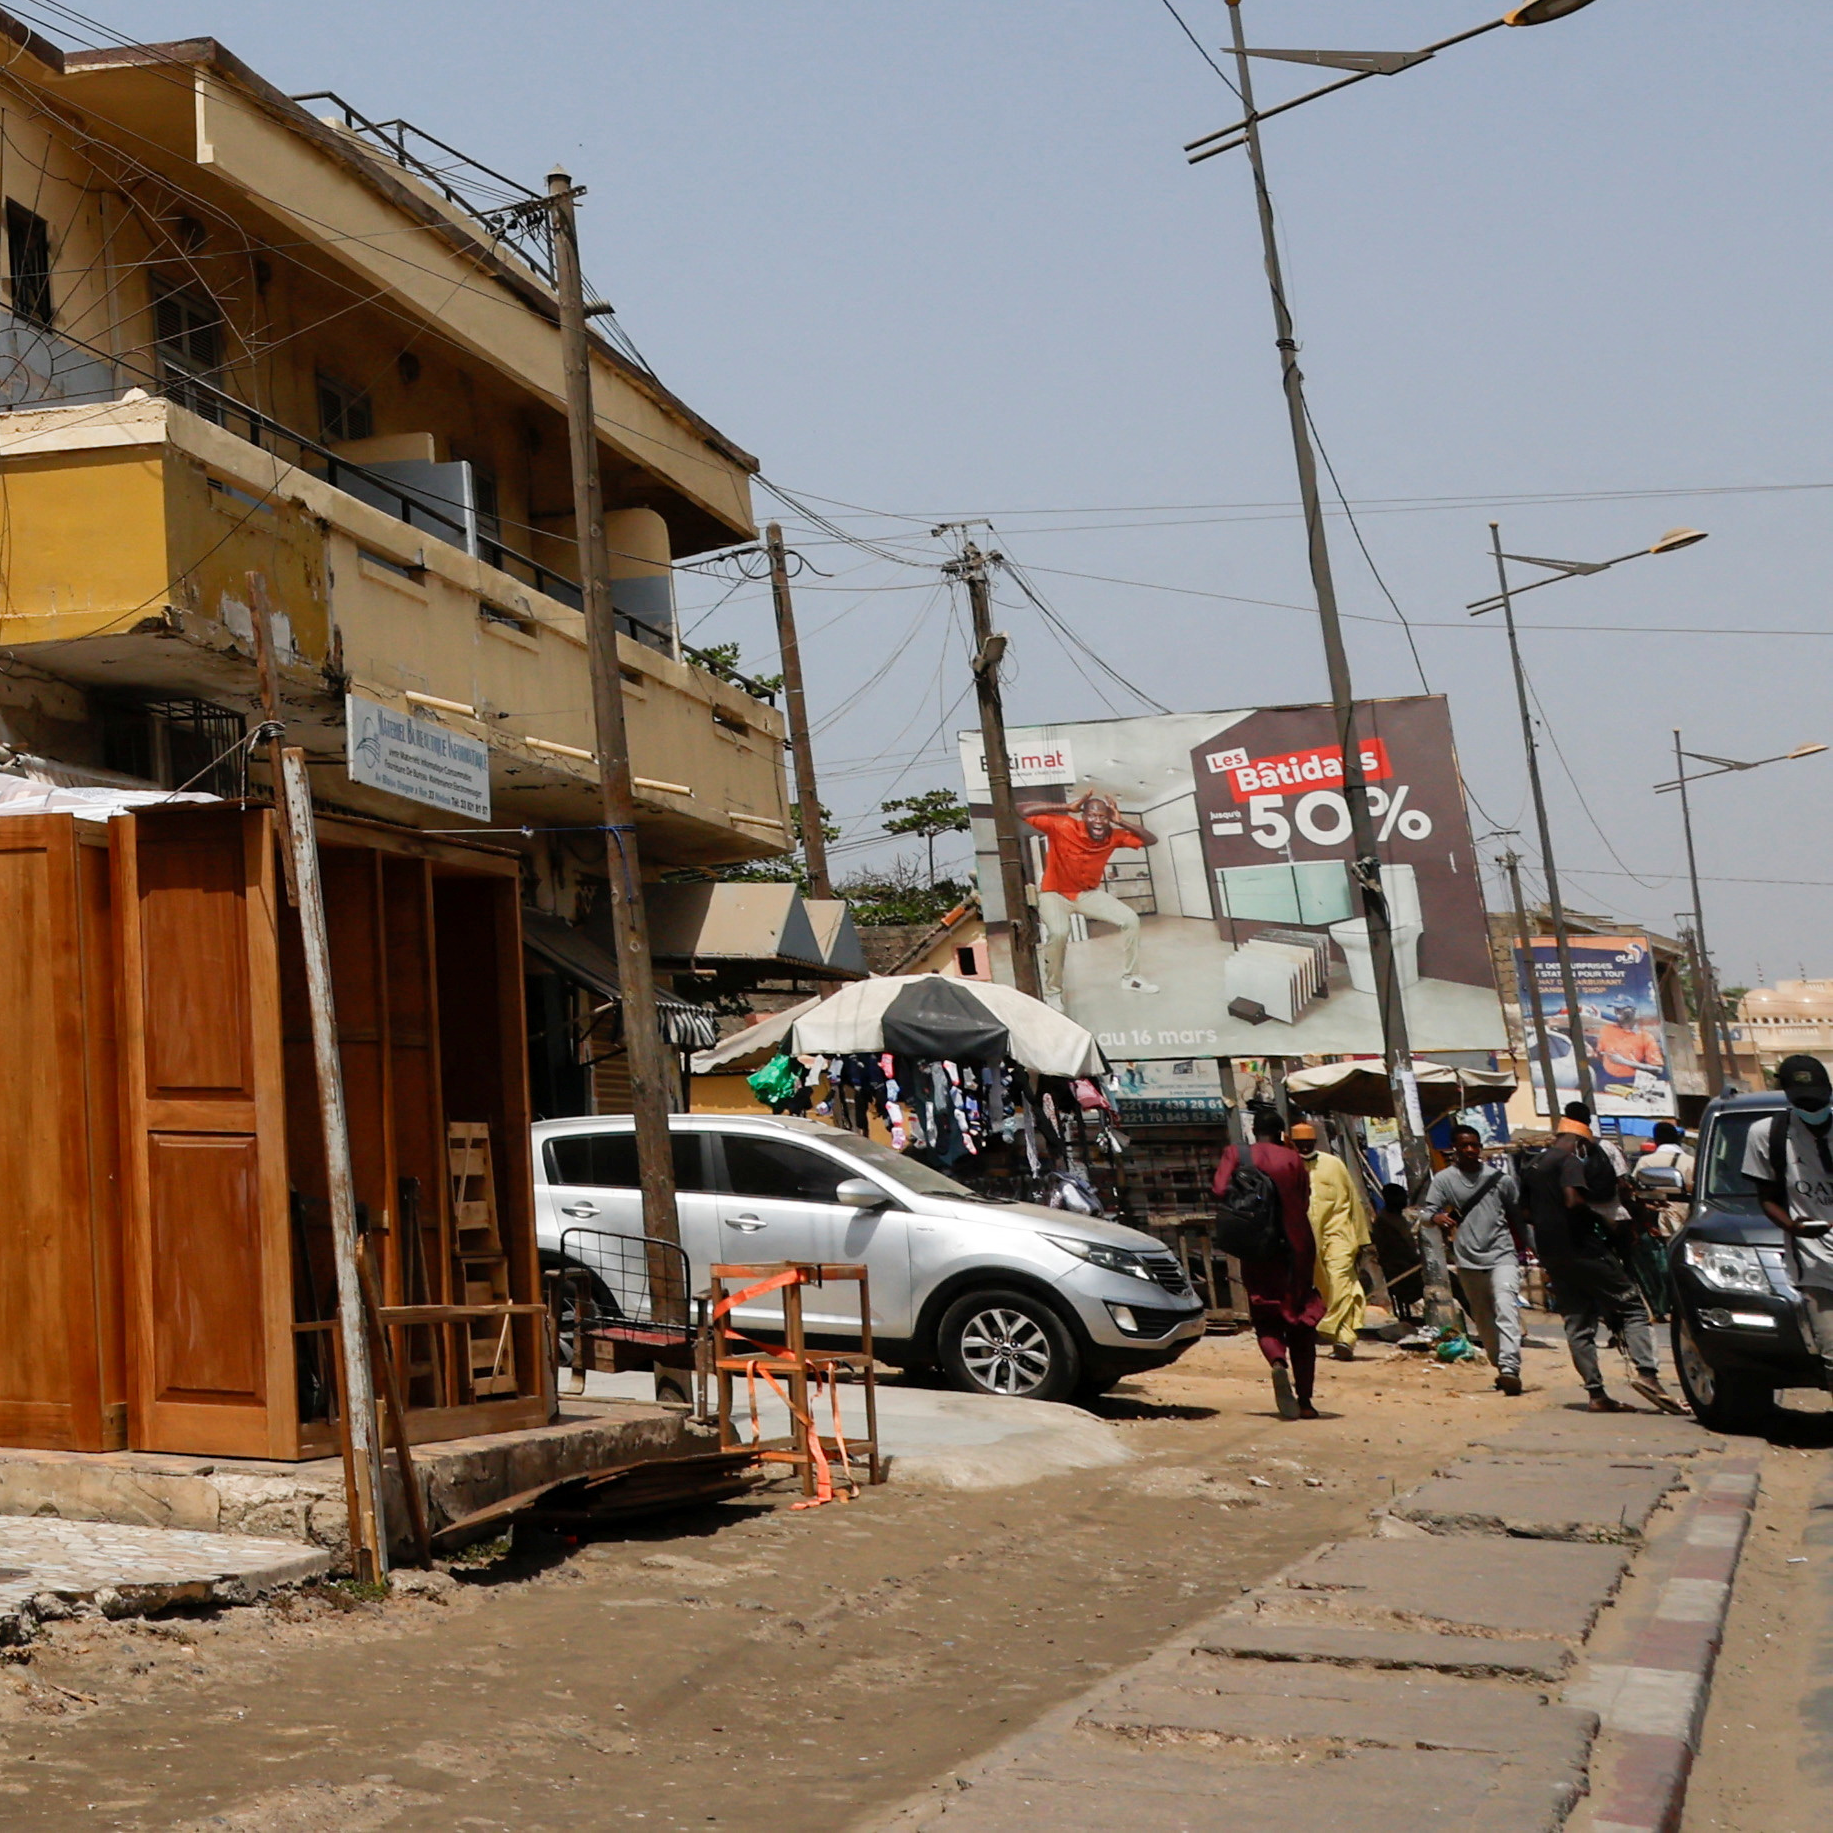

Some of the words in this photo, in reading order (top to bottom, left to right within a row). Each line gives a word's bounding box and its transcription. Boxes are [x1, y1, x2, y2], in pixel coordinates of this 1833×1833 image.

[1212, 752, 1244, 770] Les
[1234, 751, 1379, 792] Bâtidas
[1615, 954, 1634, 962] OLA
[1098, 1032, 1126, 1046] au
[1130, 1030, 1152, 1046] 16
[1158, 1028, 1218, 1045] mars
[1191, 1099, 1206, 1109] 28
[1208, 1099, 1223, 1109] 61
